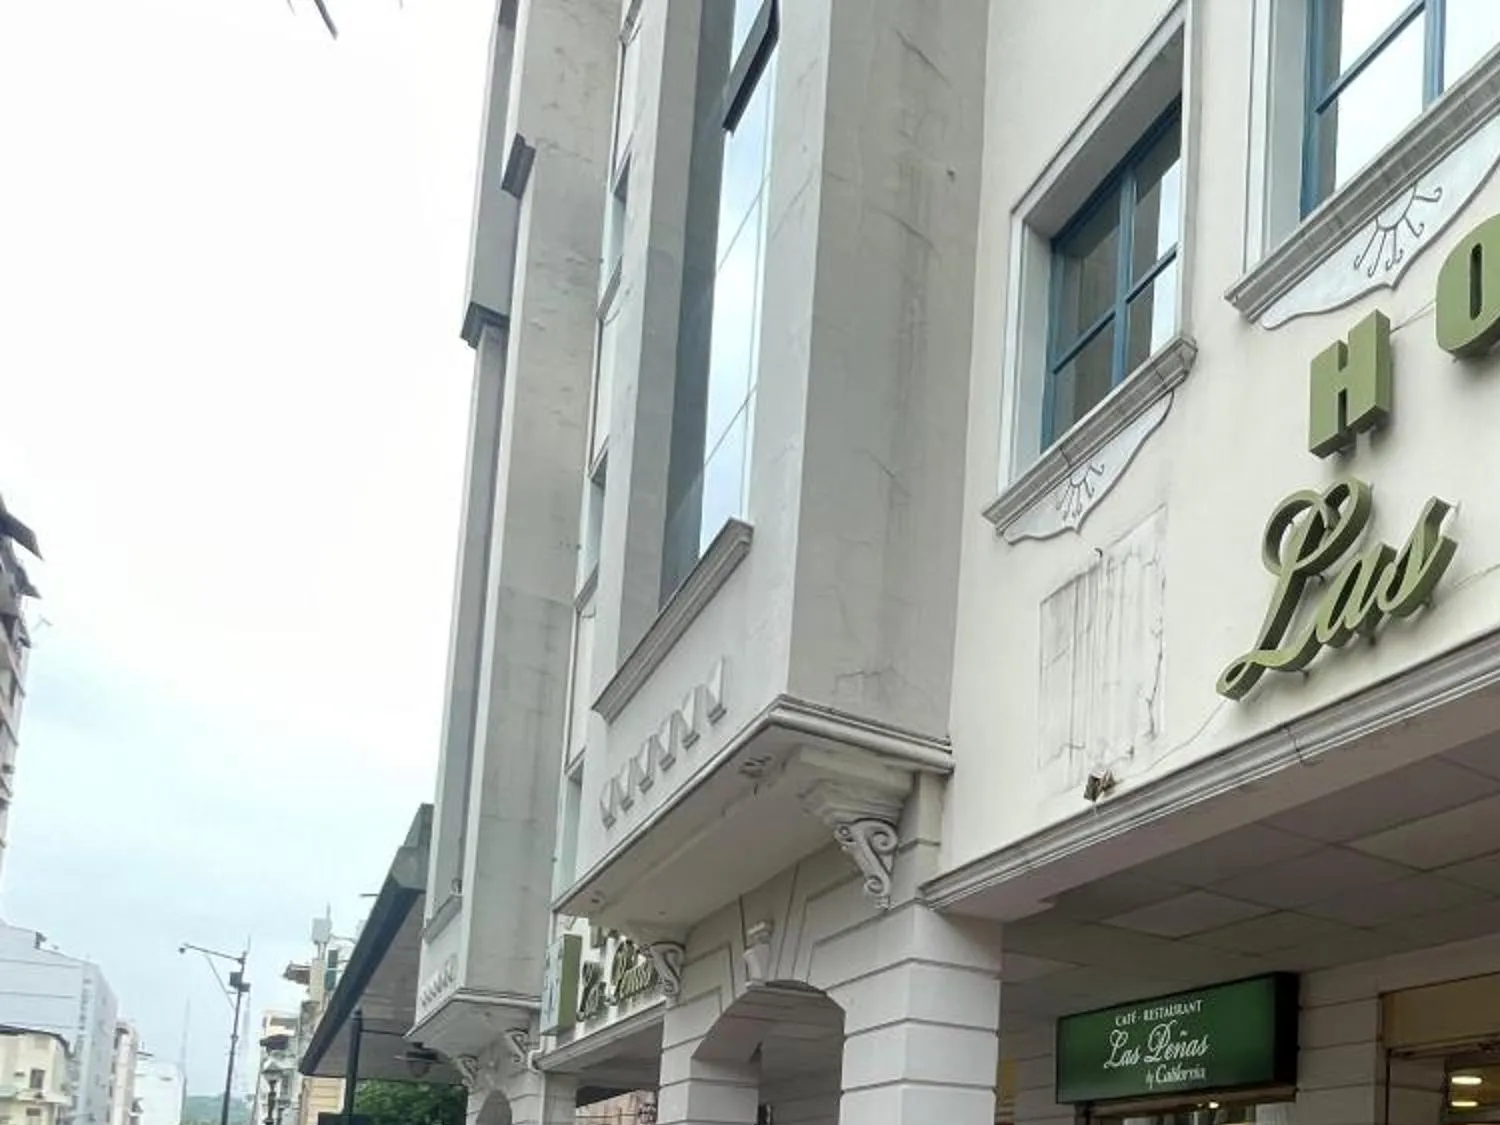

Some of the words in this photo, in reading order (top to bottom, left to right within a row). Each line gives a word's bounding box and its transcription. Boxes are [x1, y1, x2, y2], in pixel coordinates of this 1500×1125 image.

[1216, 475, 1458, 701] Las
[1143, 1000, 1202, 1020] RESTAURANT
[1103, 1029, 1141, 1068] Las
[1143, 1019, 1209, 1063] Peñas
